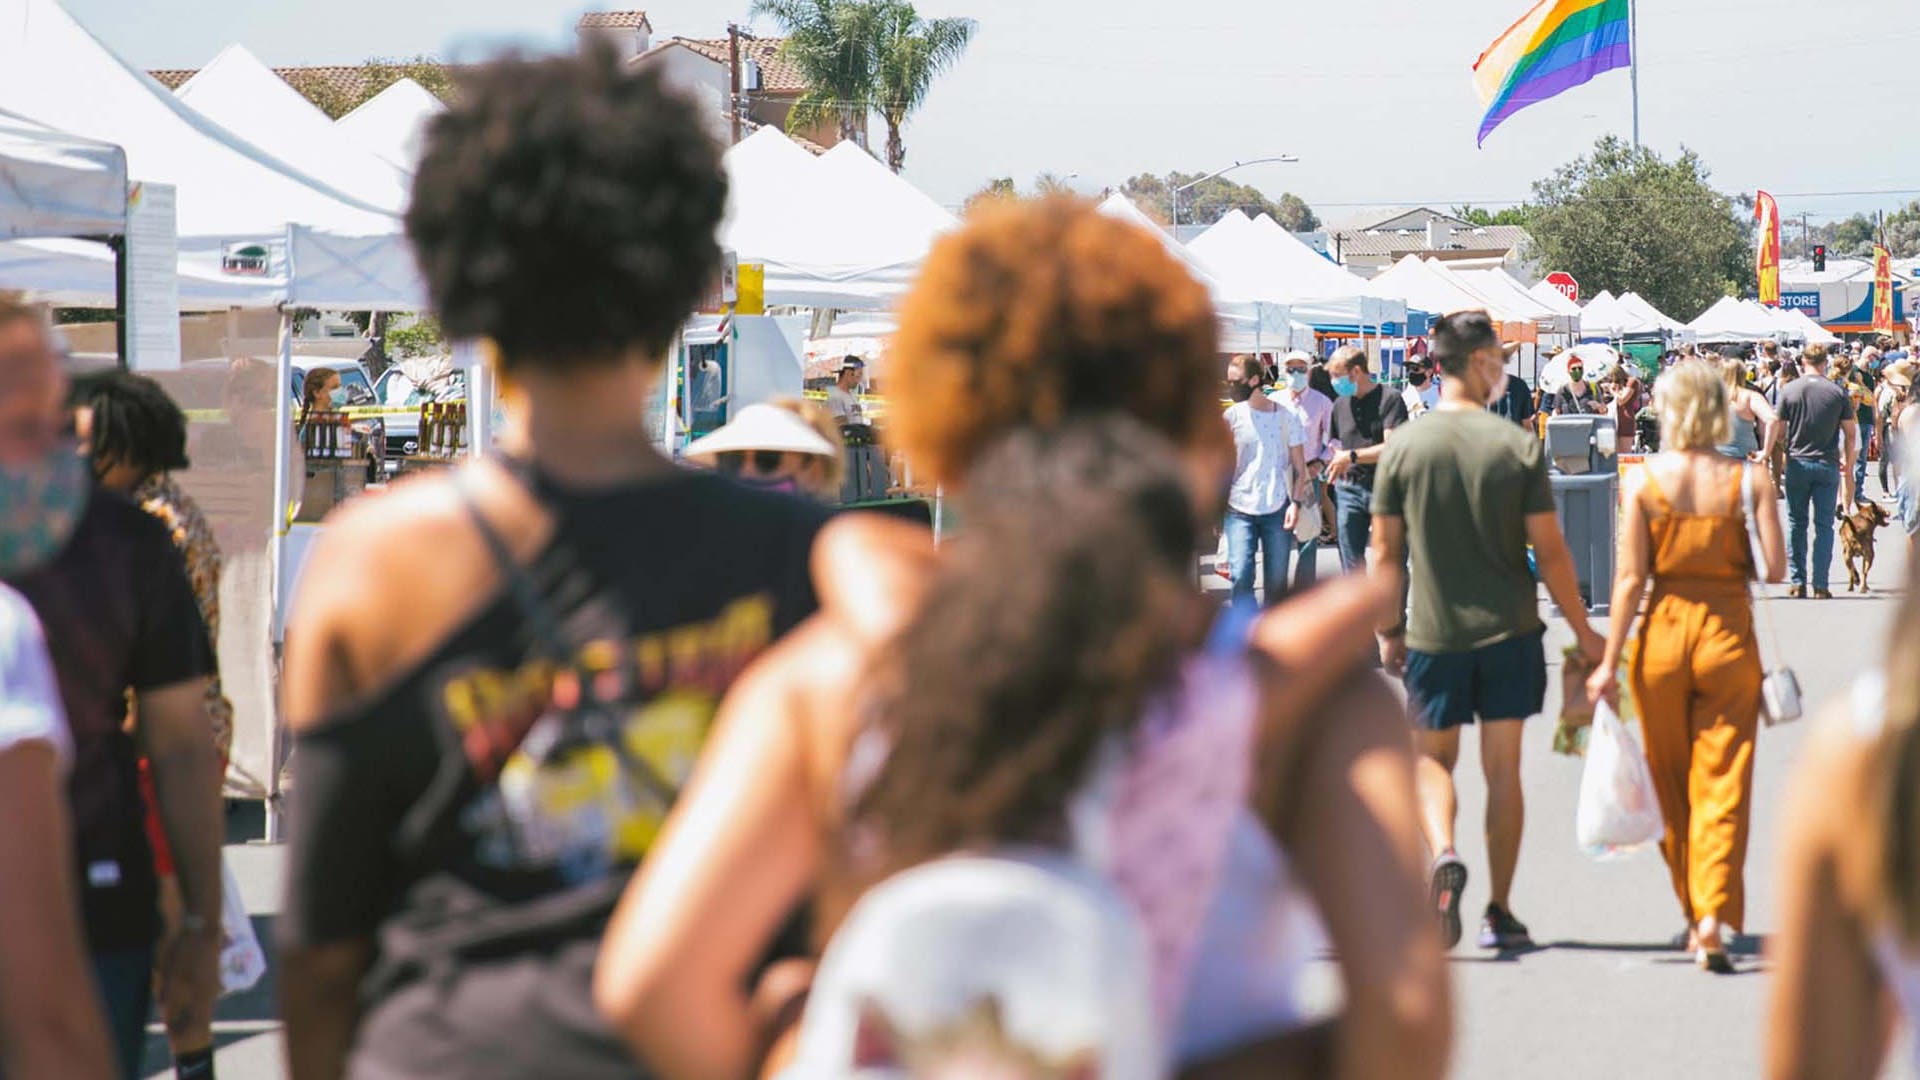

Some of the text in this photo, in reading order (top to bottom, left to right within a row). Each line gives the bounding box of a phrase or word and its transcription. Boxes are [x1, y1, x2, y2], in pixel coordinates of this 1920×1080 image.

[1551, 283, 1575, 298] TOP
[1873, 255, 1890, 329] ATM
[1780, 296, 1817, 306] STORE
